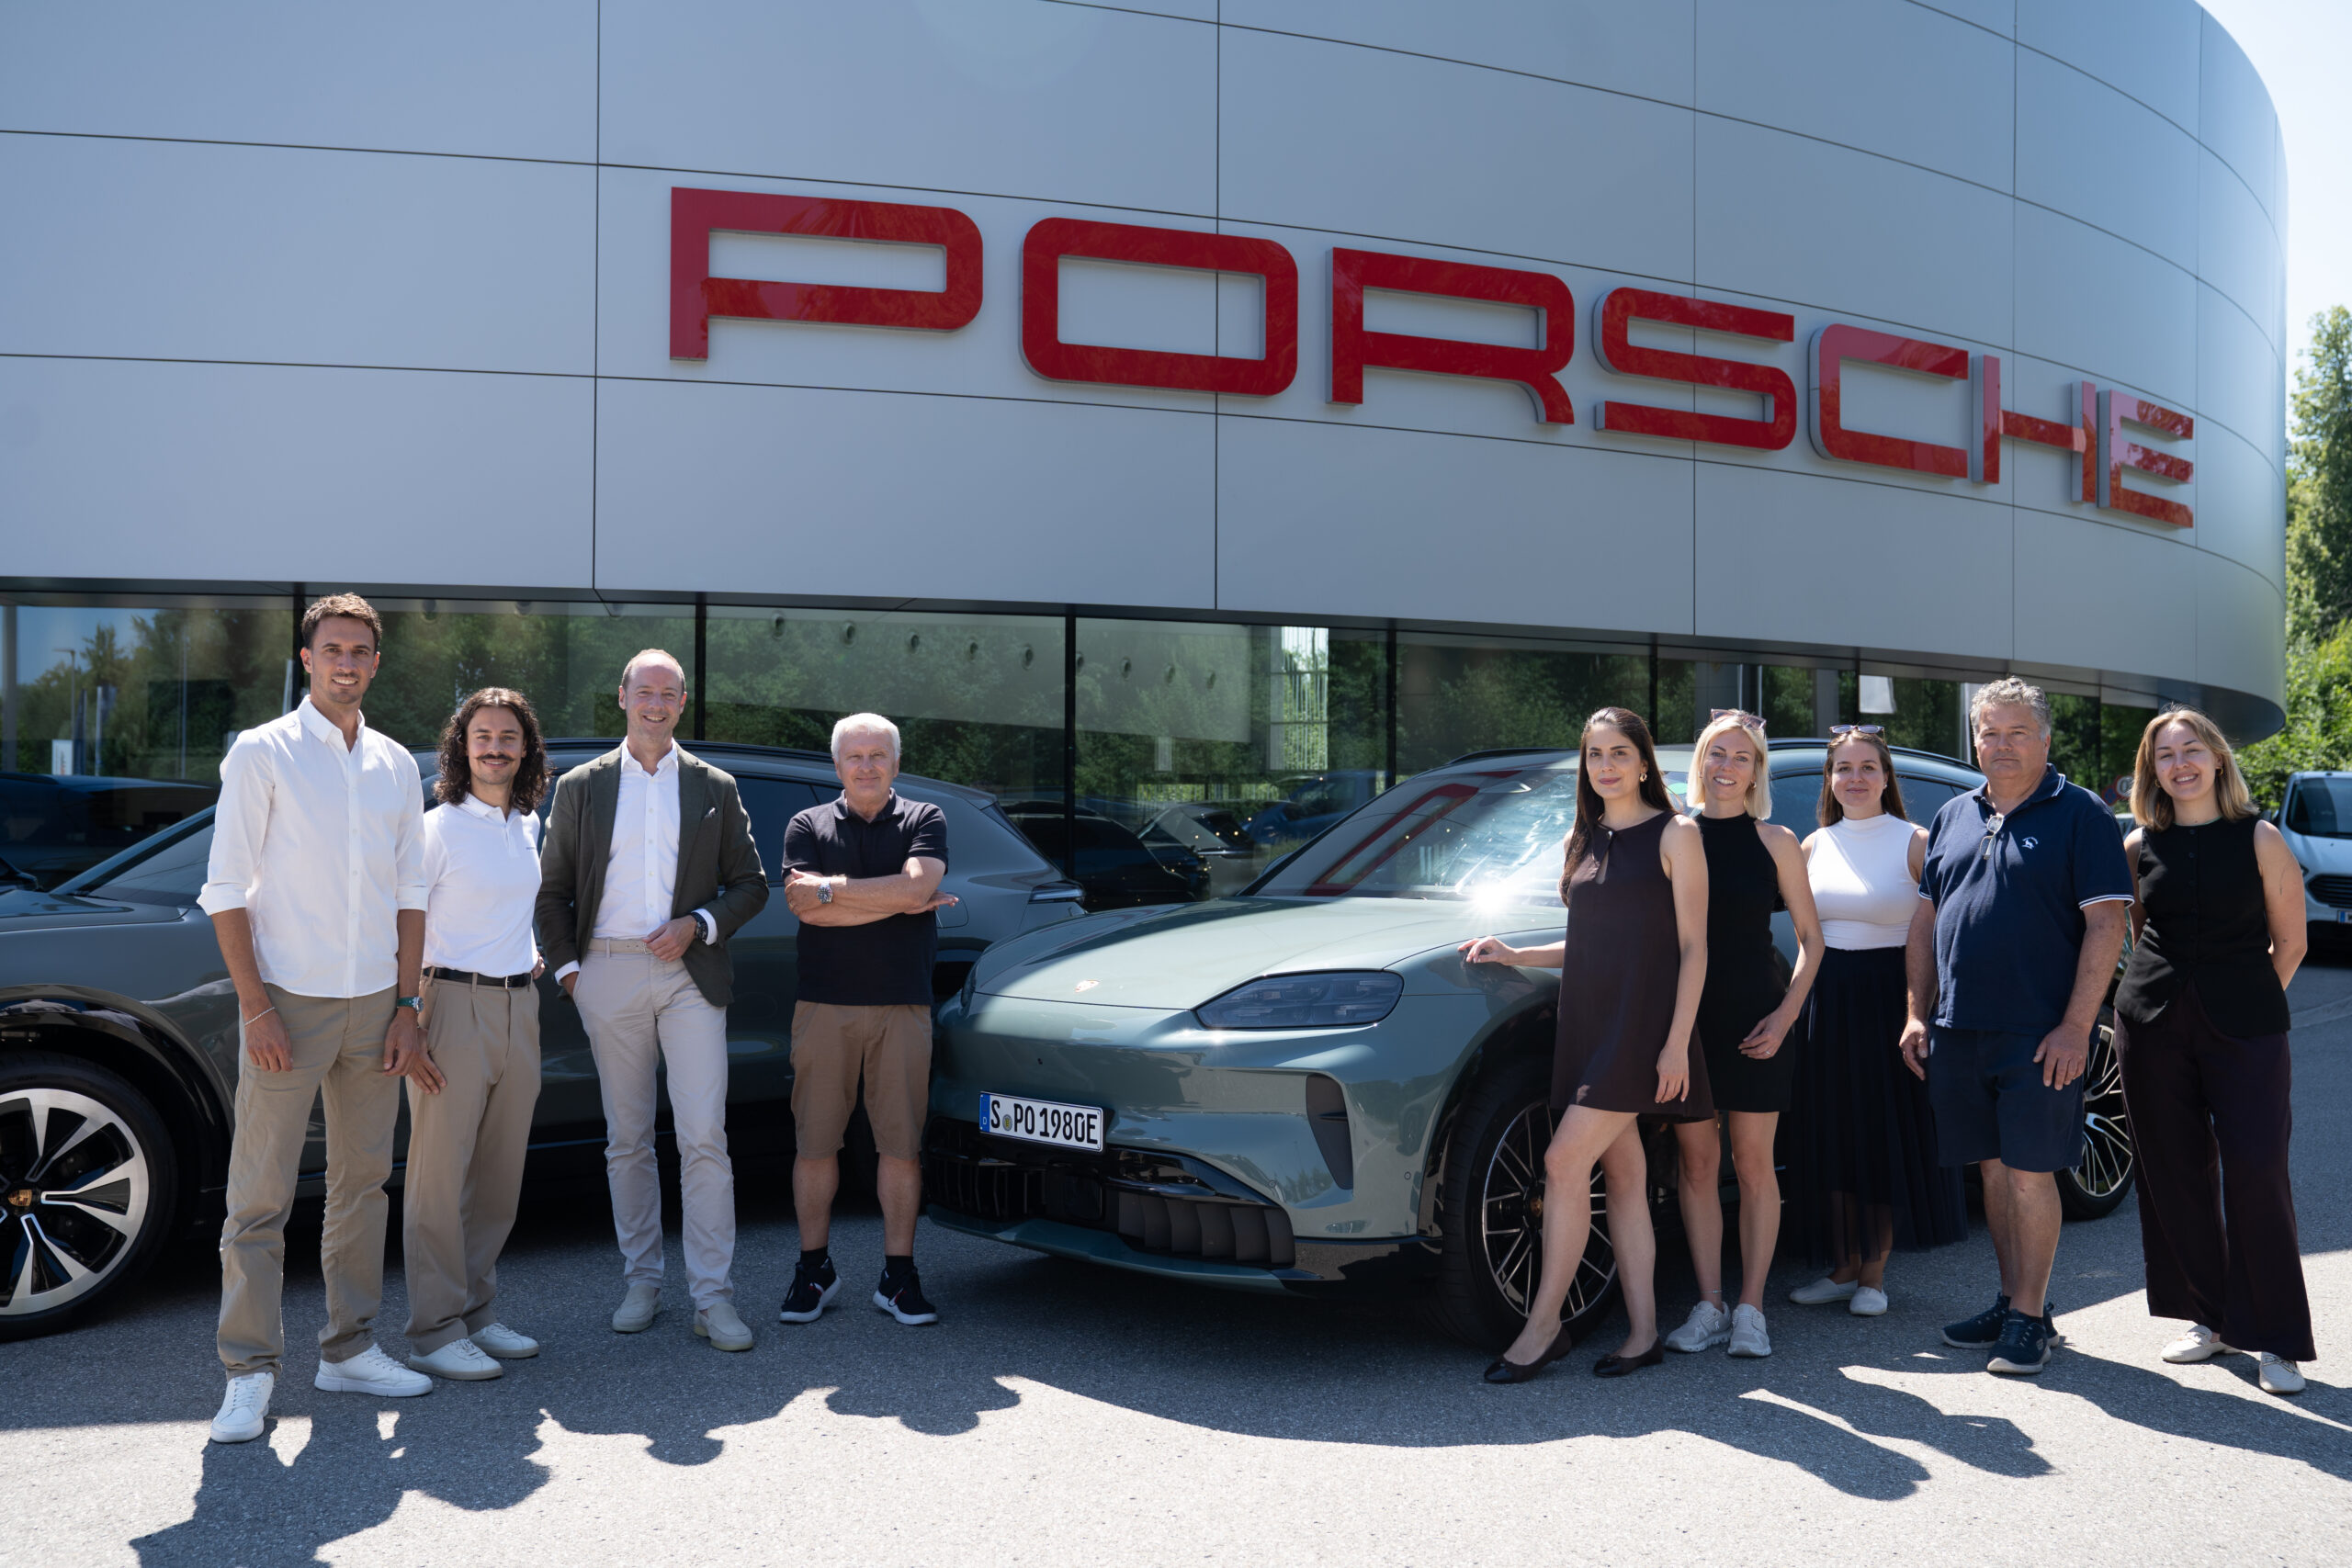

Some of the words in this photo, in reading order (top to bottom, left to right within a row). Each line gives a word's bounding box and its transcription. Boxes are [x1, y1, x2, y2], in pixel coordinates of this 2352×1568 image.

[671, 186, 2194, 528] PORSCHE
[982, 1116, 988, 1125] D
[990, 1100, 1001, 1129] S
[1013, 1102, 1035, 1134] PO
[1039, 1107, 1098, 1145] 1980E
